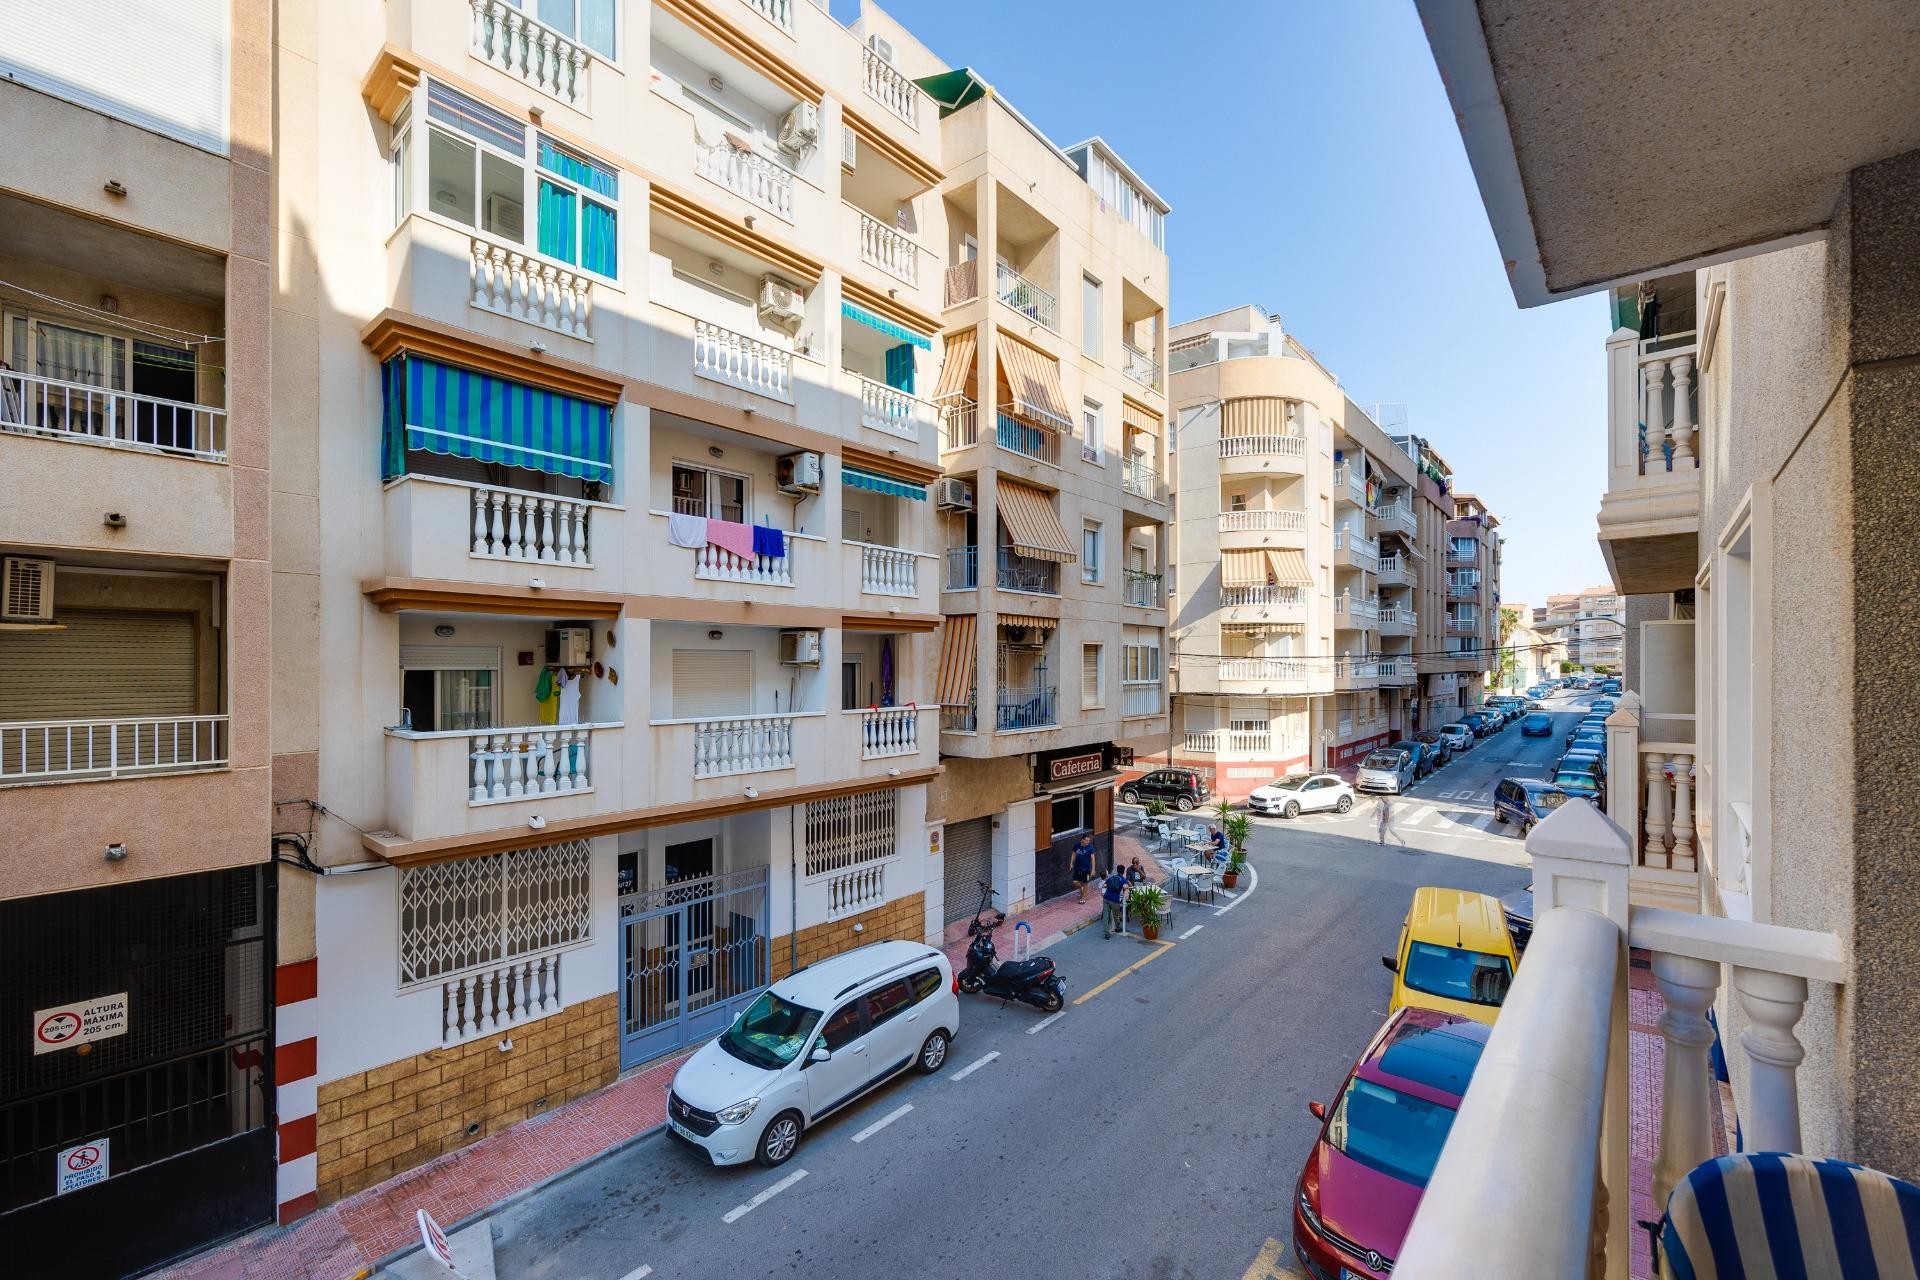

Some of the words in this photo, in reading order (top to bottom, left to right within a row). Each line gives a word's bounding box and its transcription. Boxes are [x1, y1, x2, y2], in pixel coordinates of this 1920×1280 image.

[1053, 757, 1100, 777] Cafeteria
[1113, 757, 1132, 766] BAR
[1437, 789, 1488, 802] TOP
[83, 1002, 124, 1016] ALTURA
[83, 1011, 124, 1026] MÁXIMA
[44, 1025, 59, 1034] 205
[83, 1025, 101, 1035] 205
[105, 1022, 124, 1031] cm.
[64, 1164, 103, 1180] PROHIBIDO
[77, 1172, 94, 1181] PASO
